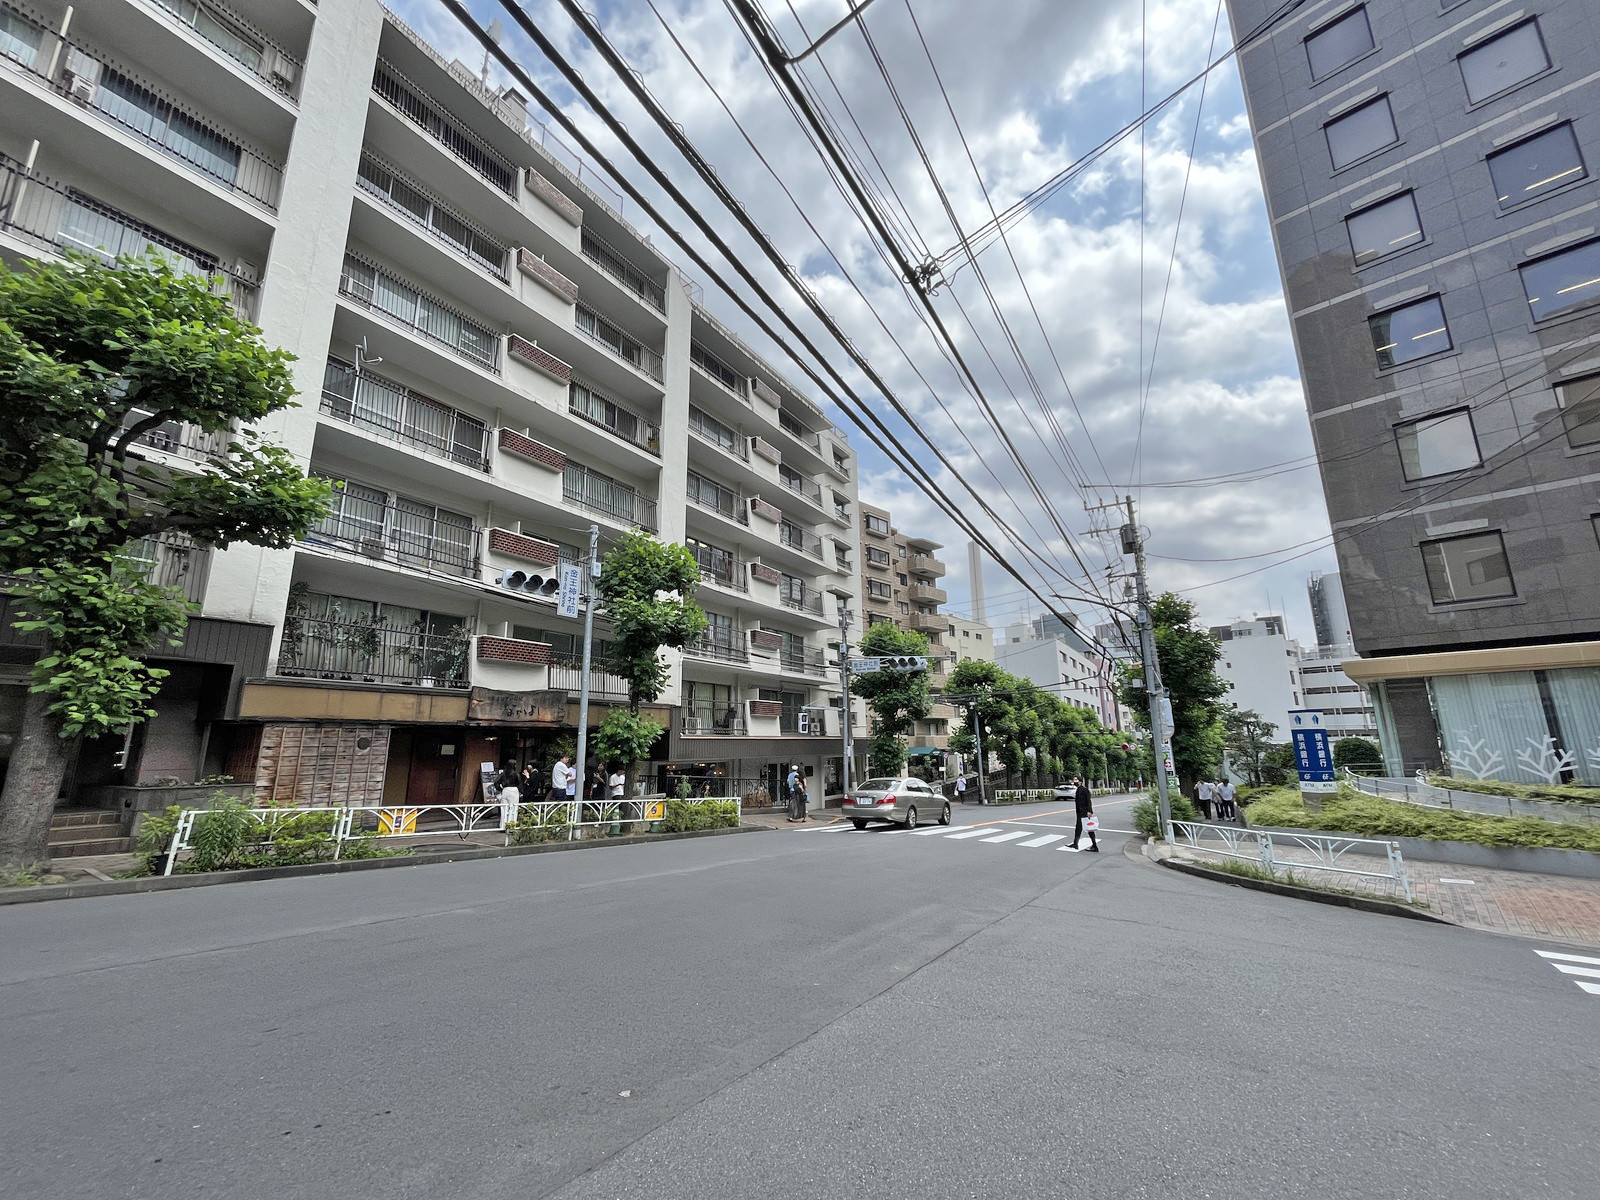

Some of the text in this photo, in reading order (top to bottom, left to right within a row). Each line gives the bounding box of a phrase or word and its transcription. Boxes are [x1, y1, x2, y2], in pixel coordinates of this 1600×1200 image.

[567, 569, 578, 614] 金王神社前
[1297, 733, 1309, 767] 横浜銀行
[1314, 733, 1327, 767] 横浜銀行
